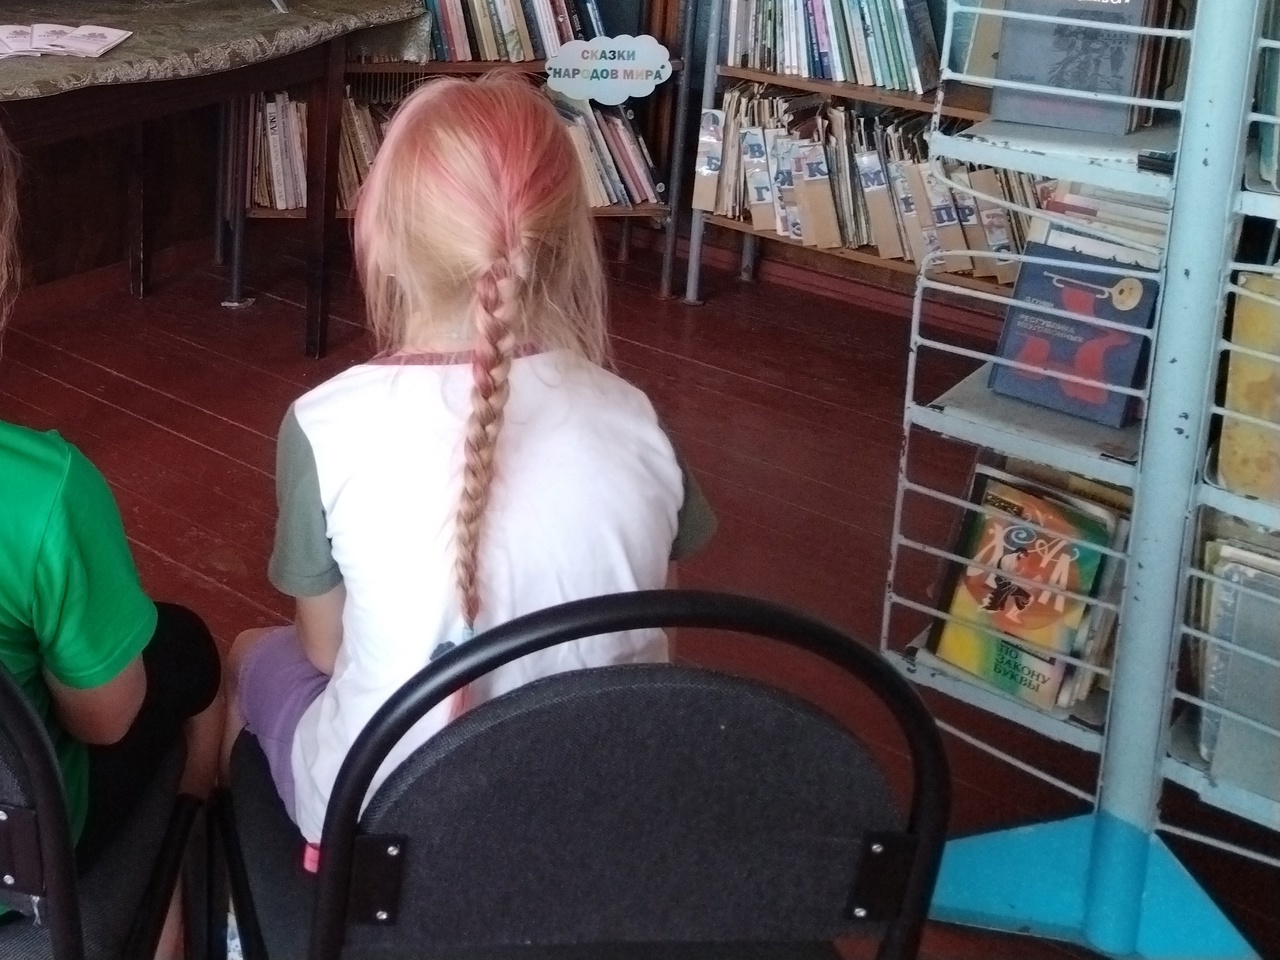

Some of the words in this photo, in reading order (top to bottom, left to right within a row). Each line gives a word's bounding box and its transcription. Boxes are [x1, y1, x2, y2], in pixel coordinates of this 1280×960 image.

[581, 49, 636, 61] СКАЗКИ
[553, 67, 619, 81] НАРОДОВ
[623, 68, 662, 81] МИРА
[748, 143, 765, 158] В
[806, 162, 828, 177] К
[860, 170, 885, 188] М
[754, 186, 770, 201] Г
[932, 206, 956, 223] П
[957, 208, 975, 223] Р
[1000, 644, 1019, 659] ПО
[995, 653, 1051, 684] ЗАКОНУ
[993, 663, 1041, 692] БУКВЫ
